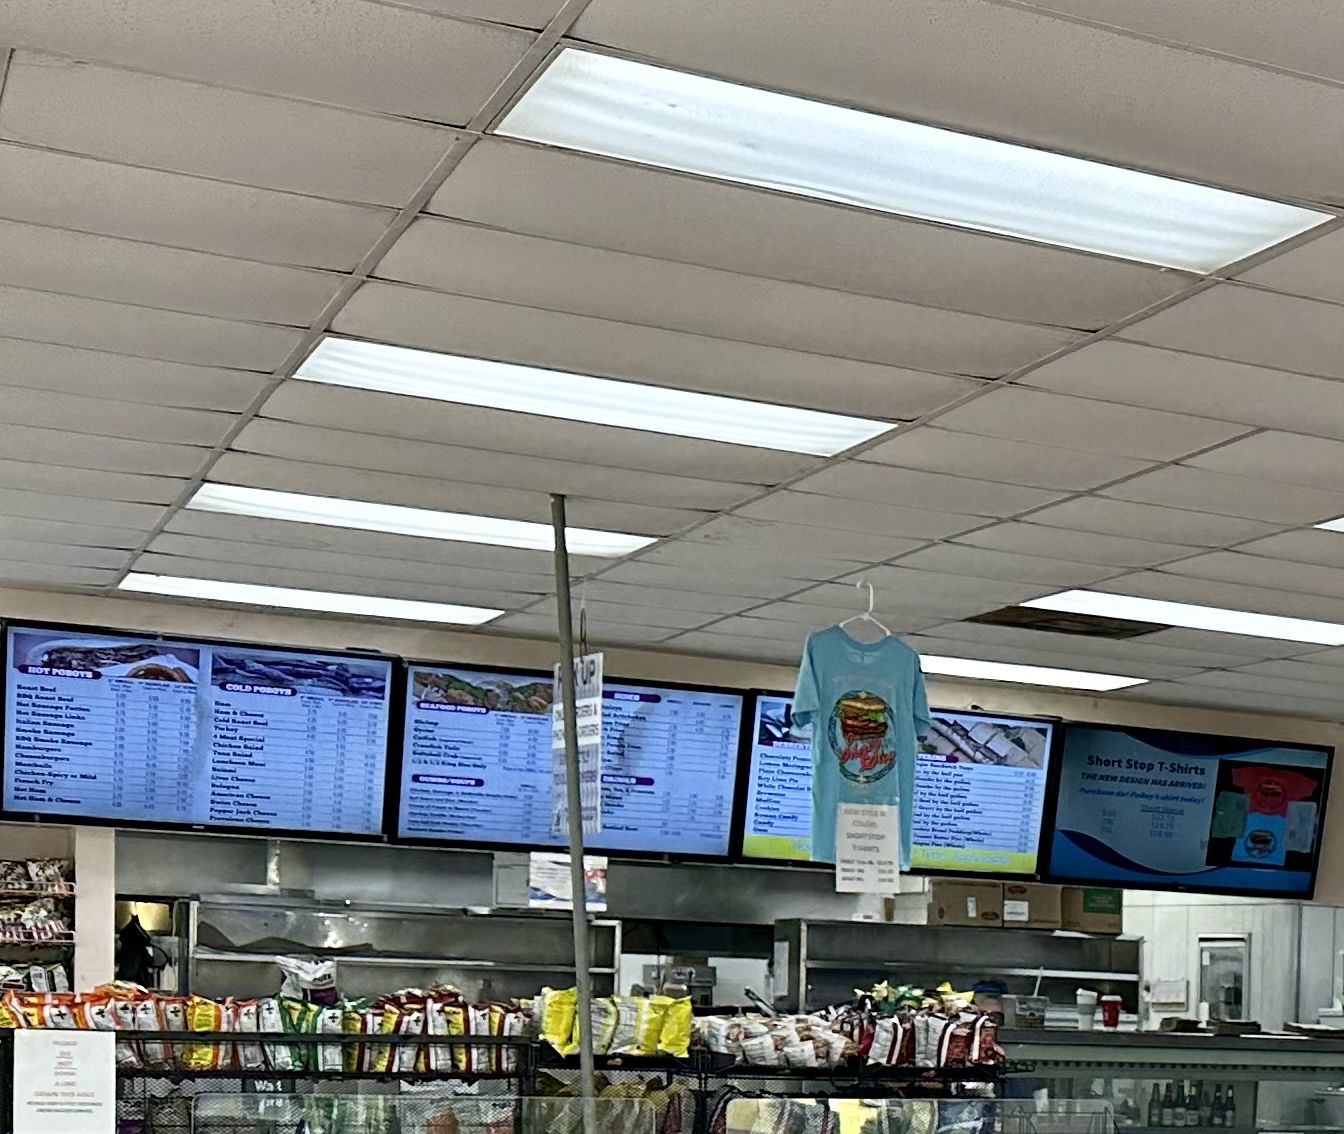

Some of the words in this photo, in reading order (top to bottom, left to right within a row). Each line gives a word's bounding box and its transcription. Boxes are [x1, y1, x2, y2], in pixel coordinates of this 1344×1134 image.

[226, 684, 252, 692] COLD
[1087, 755, 1122, 769] Short
[1126, 758, 1154, 773] Stop
[1158, 762, 1206, 776] T-Shirts
[1081, 772, 1098, 780] THE
[1100, 773, 1119, 783] NEW
[1121, 775, 1151, 785] DESIGN
[1150, 779, 1167, 787] HAS
[1167, 781, 1206, 791] ARRIVED!
